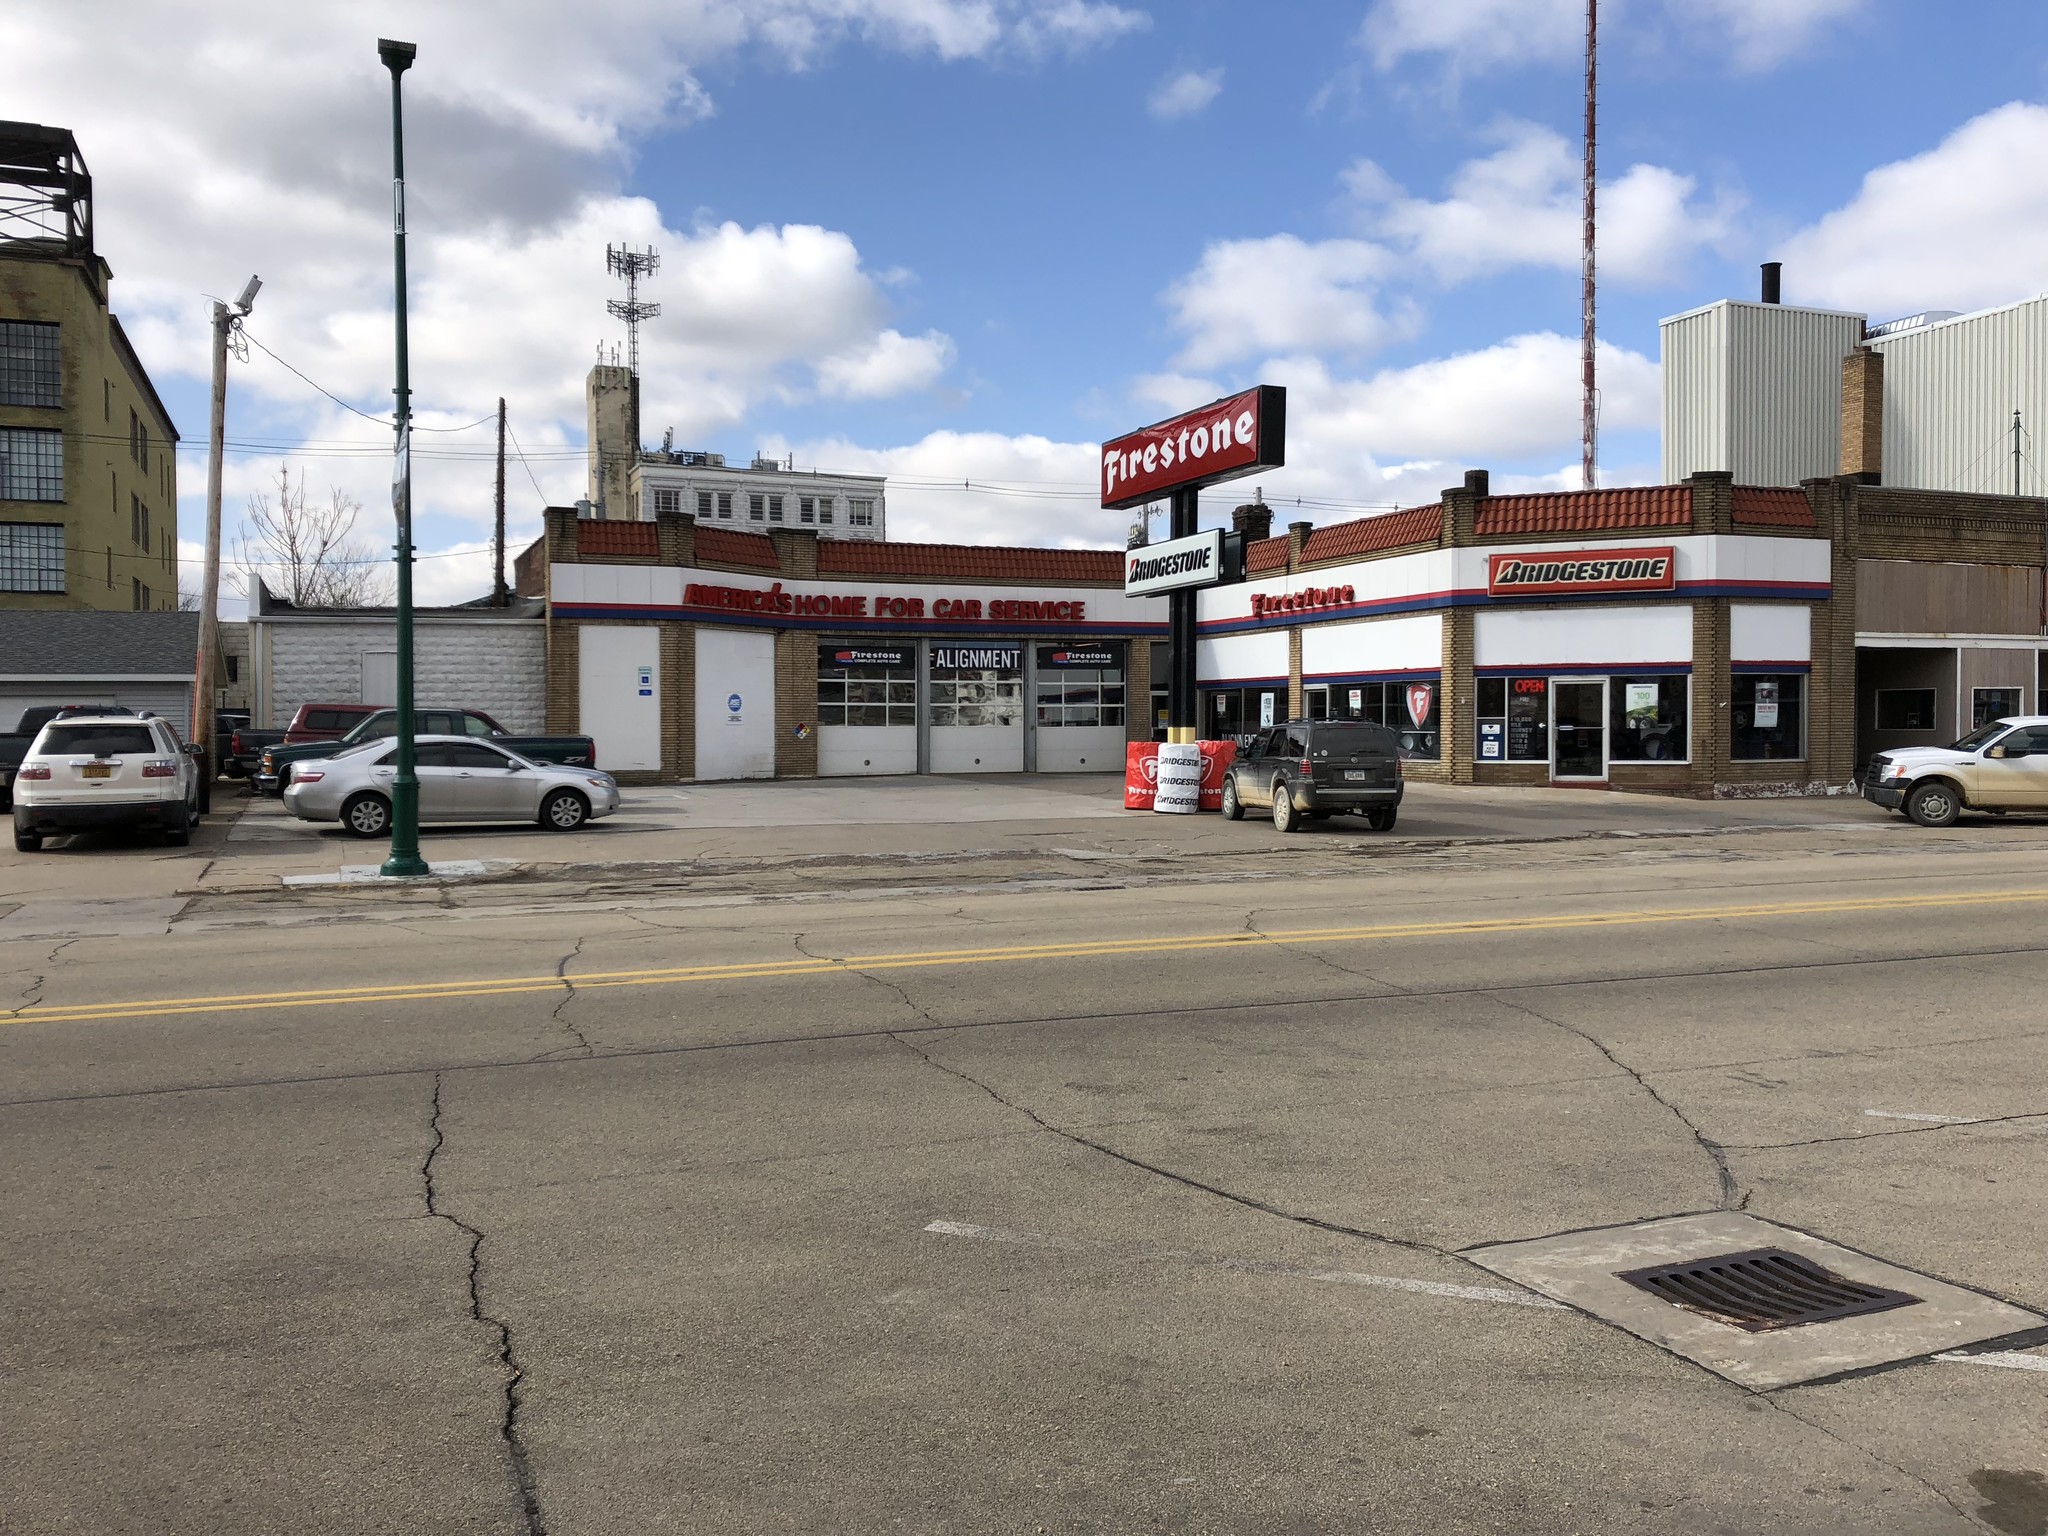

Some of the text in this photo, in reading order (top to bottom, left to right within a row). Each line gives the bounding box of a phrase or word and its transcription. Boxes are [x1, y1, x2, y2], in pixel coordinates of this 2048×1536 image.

[1104, 410, 1254, 496] Firestone
[1128, 546, 1212, 584] BRIDGESTONE
[1494, 557, 1669, 585] BRIDGESTONE
[685, 582, 1085, 620] AMERICA'S HOME FOR CAR SERVICE
[1251, 584, 1354, 617] Firestone
[851, 651, 901, 659] Firestone
[936, 649, 1021, 669] ALIGNMENT
[1066, 652, 1112, 660] Firestone
[1514, 679, 1544, 693] OPEN
